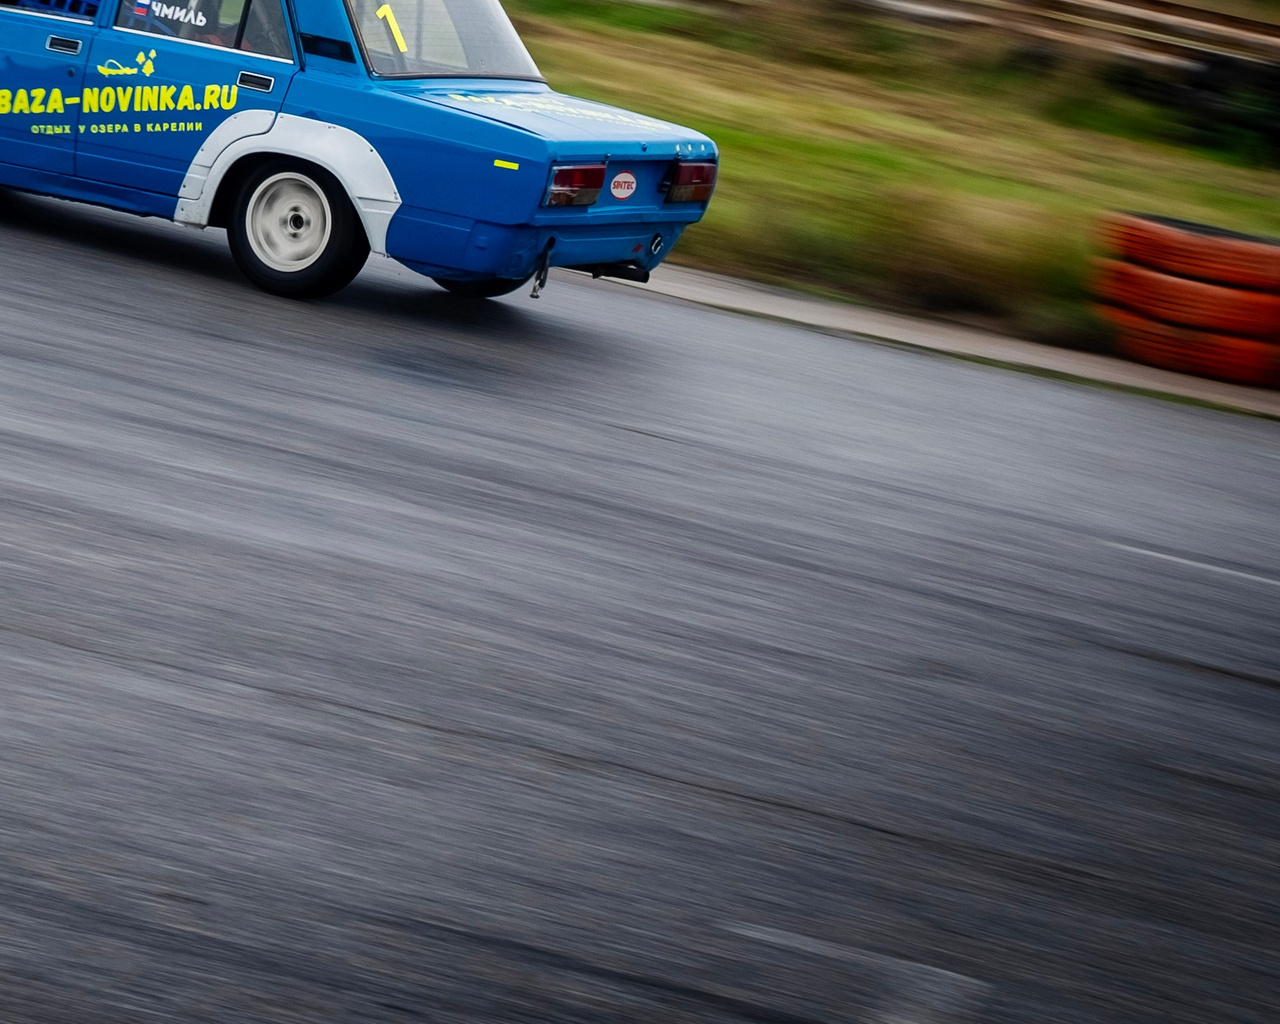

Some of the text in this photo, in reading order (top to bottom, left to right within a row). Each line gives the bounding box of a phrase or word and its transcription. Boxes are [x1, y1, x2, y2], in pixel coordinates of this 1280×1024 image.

[151, 1, 207, 27] ЧМИЛЬ
[376, 4, 408, 53] 1
[30, 124, 71, 135] ОТДЫХ
[90, 123, 129, 134] ОЗЕРА
[133, 123, 142, 133] В
[146, 121, 203, 133] КАРЕЛИИ
[612, 180, 635, 190] SINTEC
